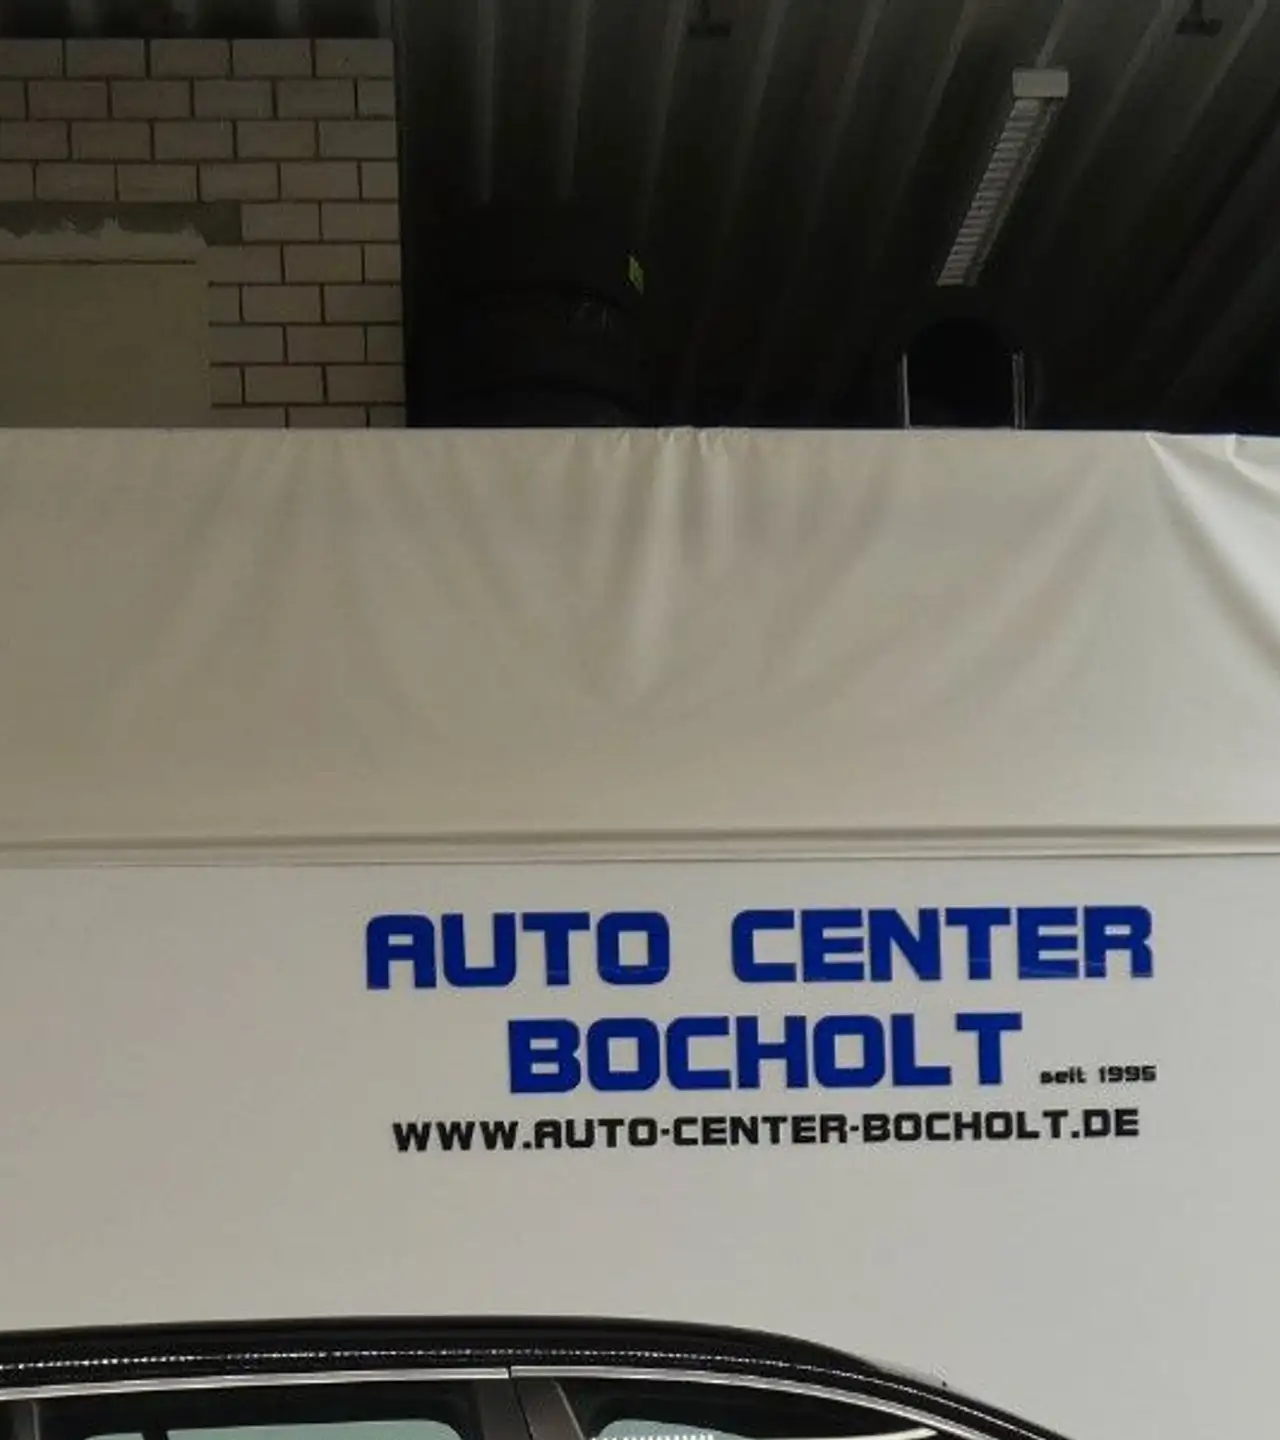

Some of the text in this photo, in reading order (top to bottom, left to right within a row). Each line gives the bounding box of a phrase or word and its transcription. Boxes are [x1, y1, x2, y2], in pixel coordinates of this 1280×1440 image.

[366, 904, 1154, 990] AUTO CENTER
[507, 1011, 1157, 1096] BOCHOLT seit 1995
[392, 1108, 1140, 1153] WWW.AUTO-CENTER-BOCHOLT.DE
